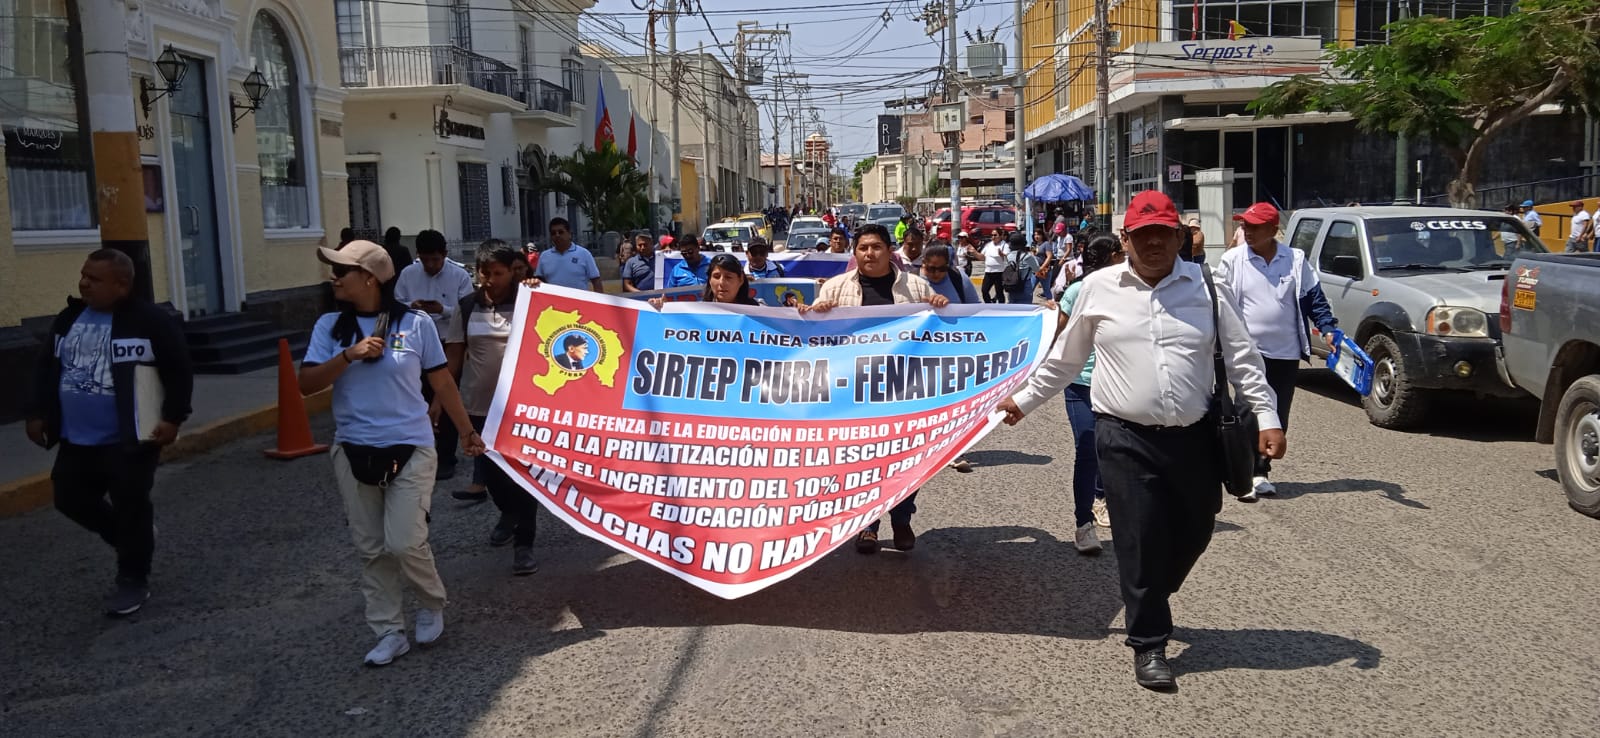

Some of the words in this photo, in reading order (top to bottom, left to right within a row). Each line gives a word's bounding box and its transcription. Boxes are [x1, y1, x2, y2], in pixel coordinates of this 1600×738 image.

[1174, 43, 1257, 64] Serpost
[1426, 220, 1487, 230] CECES
[113, 343, 145, 358] bro
[664, 328, 700, 342] POR
[706, 329, 743, 343] UNA
[749, 330, 802, 347] LÍNEA
[808, 332, 892, 347] SINDICAL
[898, 330, 987, 343] CLASISTA
[632, 349, 738, 401] SIRTEP
[740, 358, 831, 405] PIURA
[836, 377, 848, 387] -
[854, 338, 1030, 403] FENATEPERÚ
[515, 404, 550, 422] POR
[553, 410, 573, 426] LA
[576, 412, 646, 435] DEFENZA
[649, 420, 671, 436] DE
[673, 422, 693, 438] LA
[696, 425, 793, 442] EDUCACIÓN
[795, 428, 824, 442] DEL
[828, 424, 889, 441] PUEBLO
[893, 421, 904, 435] Y
[907, 413, 949, 433] PARA
[952, 404, 967, 418] EL
[512, 423, 552, 444] ¡NO
[554, 430, 571, 449] A
[574, 434, 601, 456] LA
[604, 438, 769, 468] PRIVATIZACIÓN
[772, 447, 801, 467] DE
[804, 447, 831, 467] LA
[835, 432, 926, 465] ESCUELA
[522, 444, 568, 469] POR
[572, 460, 595, 478] EL
[600, 468, 745, 500] INCREMENTO
[749, 479, 789, 500] DEL
[793, 475, 840, 498] 10%
[844, 467, 883, 491] DEL
[886, 455, 923, 479] PBI
[926, 420, 975, 459] PARA
[649, 502, 783, 528] EDUCACIÓN
[787, 487, 881, 525] PÚBLICA
[564, 485, 696, 565] LUCHAS
[702, 541, 753, 574] NO
[759, 527, 831, 571] HAY
